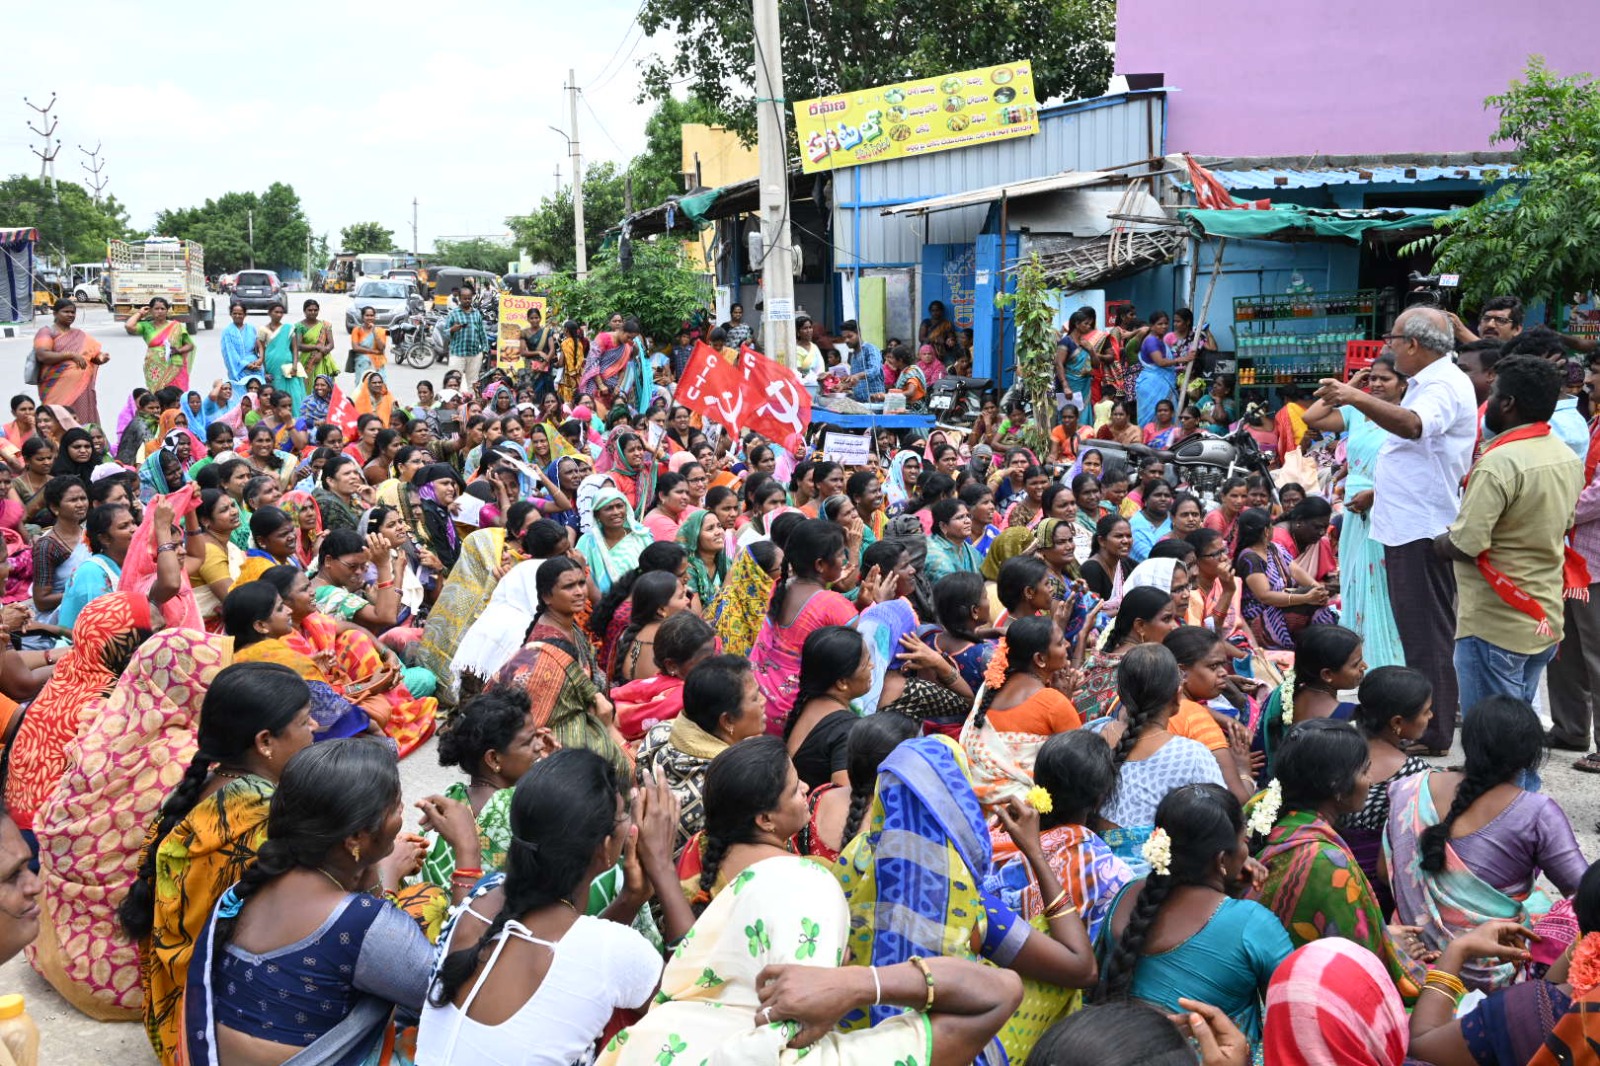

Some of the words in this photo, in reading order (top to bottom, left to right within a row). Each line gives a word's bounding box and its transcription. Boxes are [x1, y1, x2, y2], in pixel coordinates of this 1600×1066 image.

[808, 100, 846, 116] రమణ
[504, 298, 543, 310] రమణ
[687, 354, 718, 400] CITU
[743, 352, 756, 382] CI
